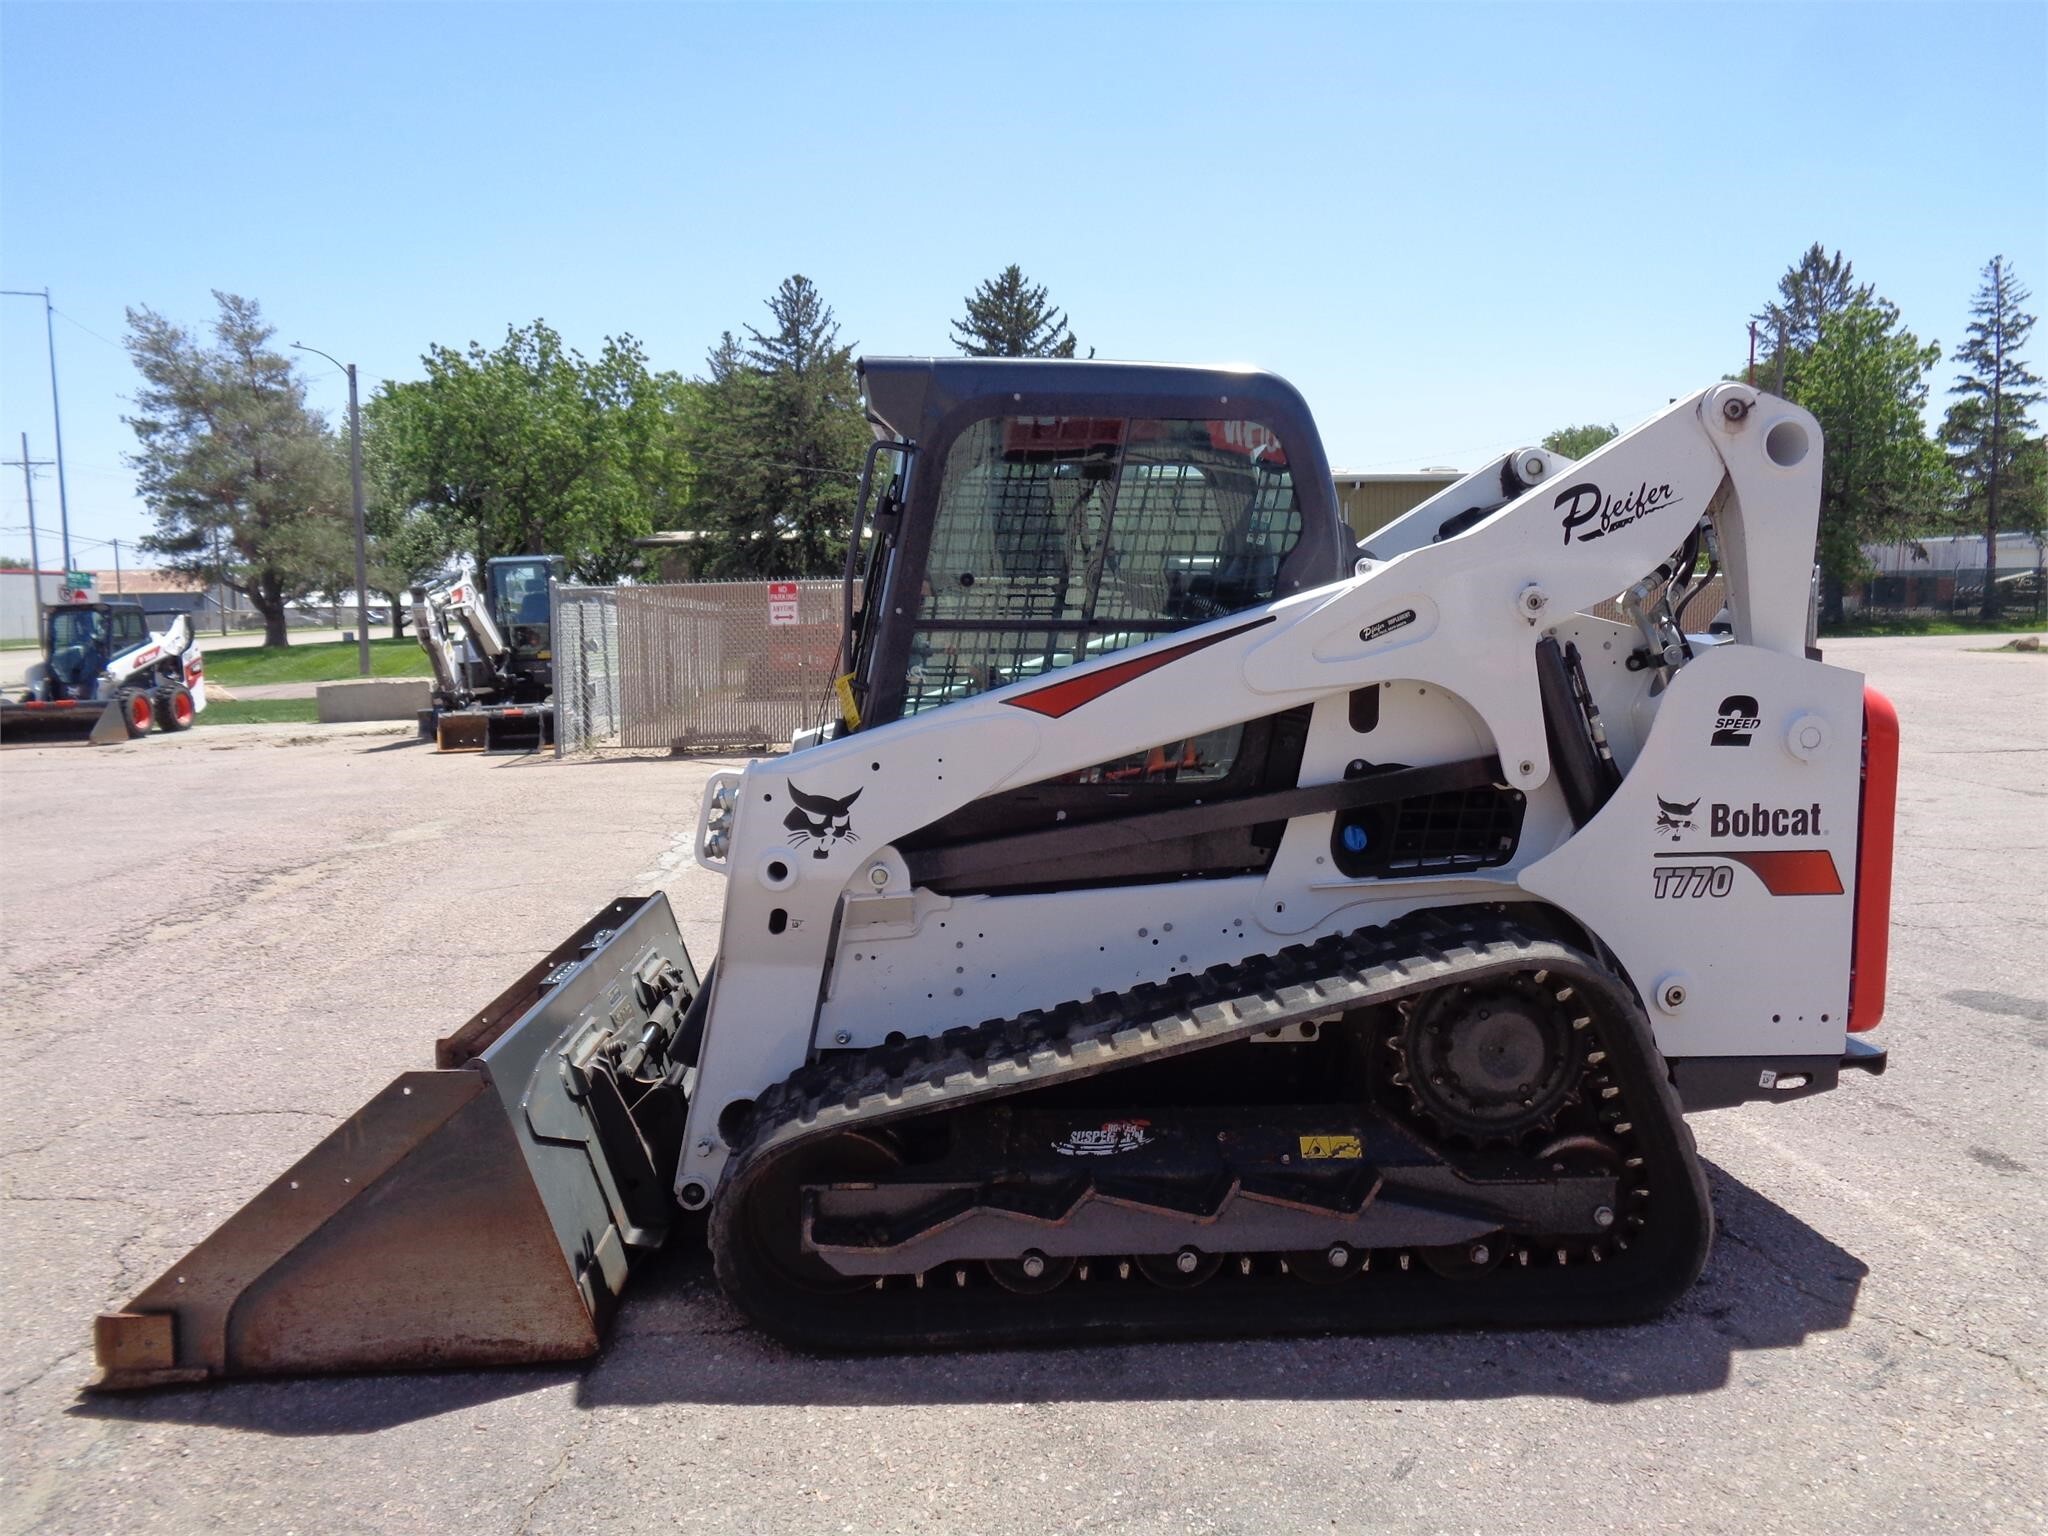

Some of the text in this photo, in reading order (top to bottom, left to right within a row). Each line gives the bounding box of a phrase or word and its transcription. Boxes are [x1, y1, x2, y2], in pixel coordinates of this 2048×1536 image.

[1554, 482, 1674, 546] Pfeifer
[770, 593, 797, 601] PARKING
[777, 585, 788, 593] NO
[1711, 695, 1759, 746] 2
[1714, 718, 1761, 729] SPEED
[1711, 803, 1821, 838] Bobcat
[1653, 866, 1734, 899] T770
